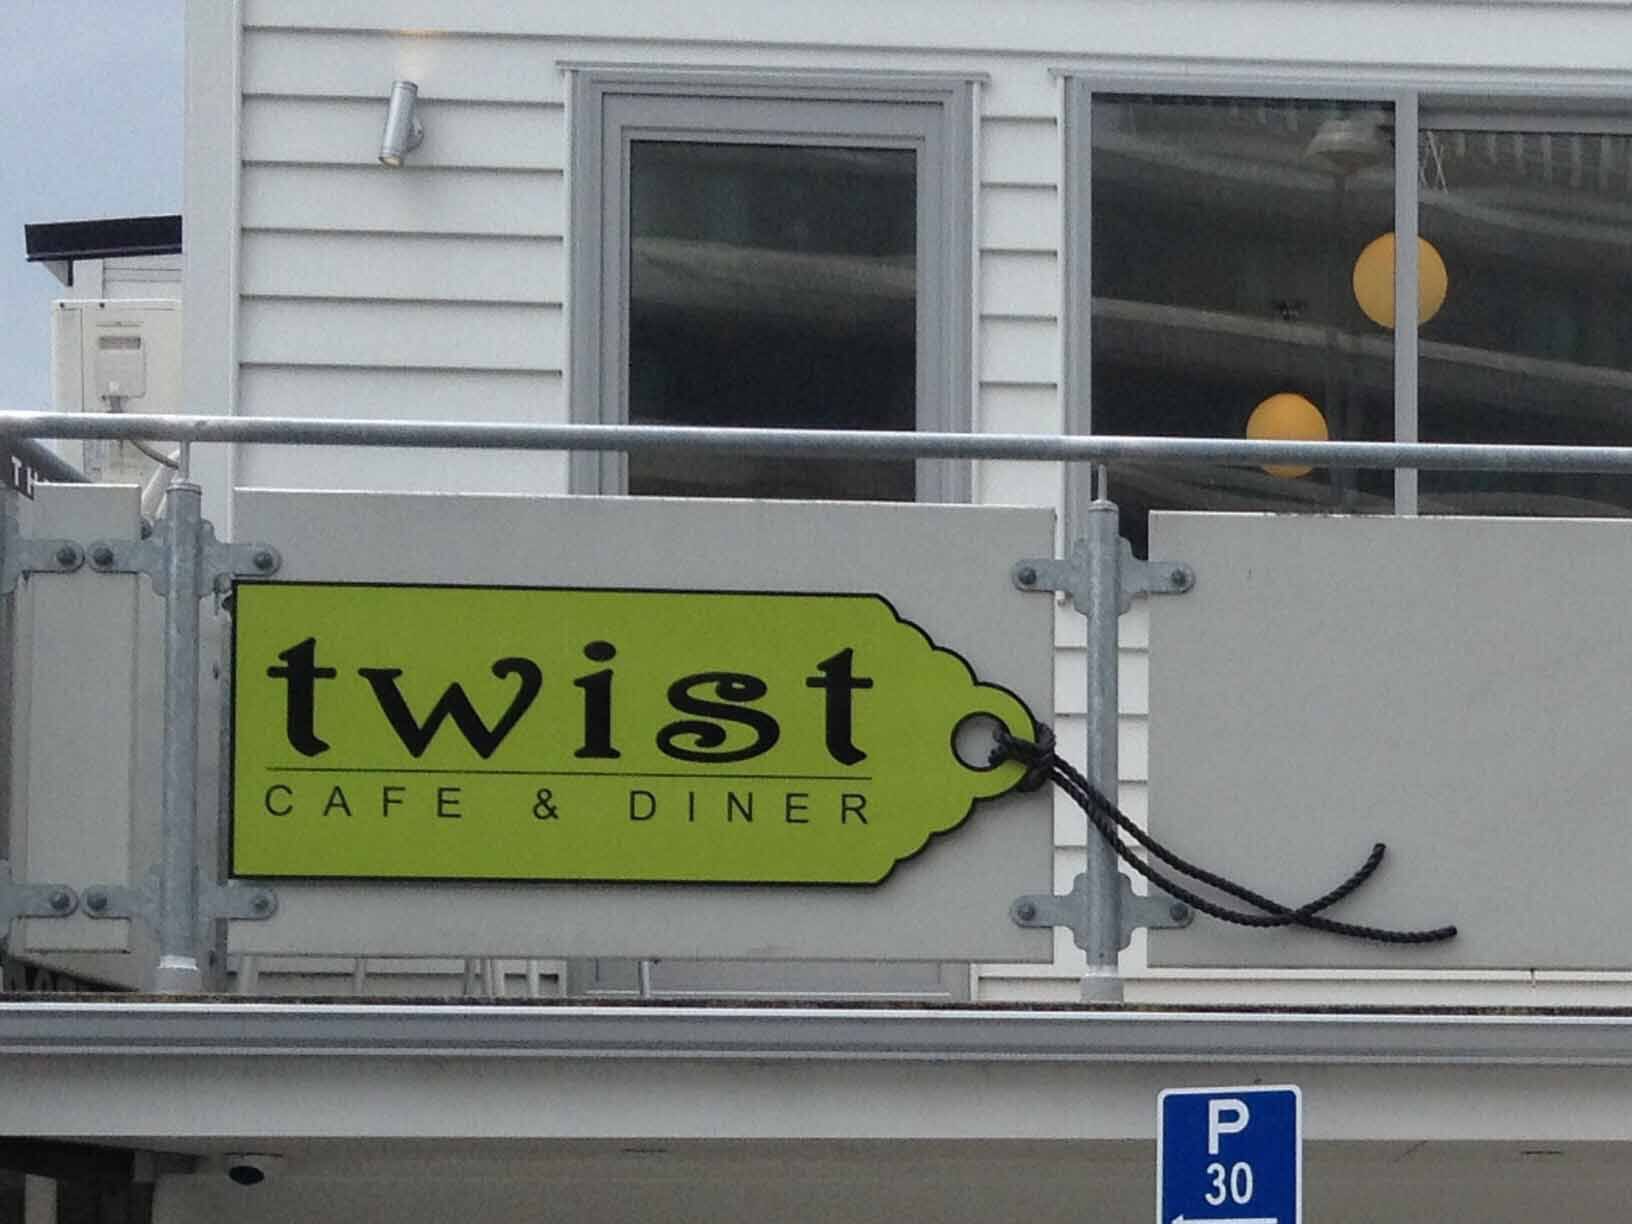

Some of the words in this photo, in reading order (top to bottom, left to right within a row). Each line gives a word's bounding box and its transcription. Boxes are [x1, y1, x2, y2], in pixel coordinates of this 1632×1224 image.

[266, 637, 875, 765] twist
[265, 783, 463, 819] CAFE
[532, 788, 560, 822] &
[629, 789, 869, 825] DINER
[1208, 1098, 1250, 1156] P
[1204, 1161, 1254, 1206] 30
